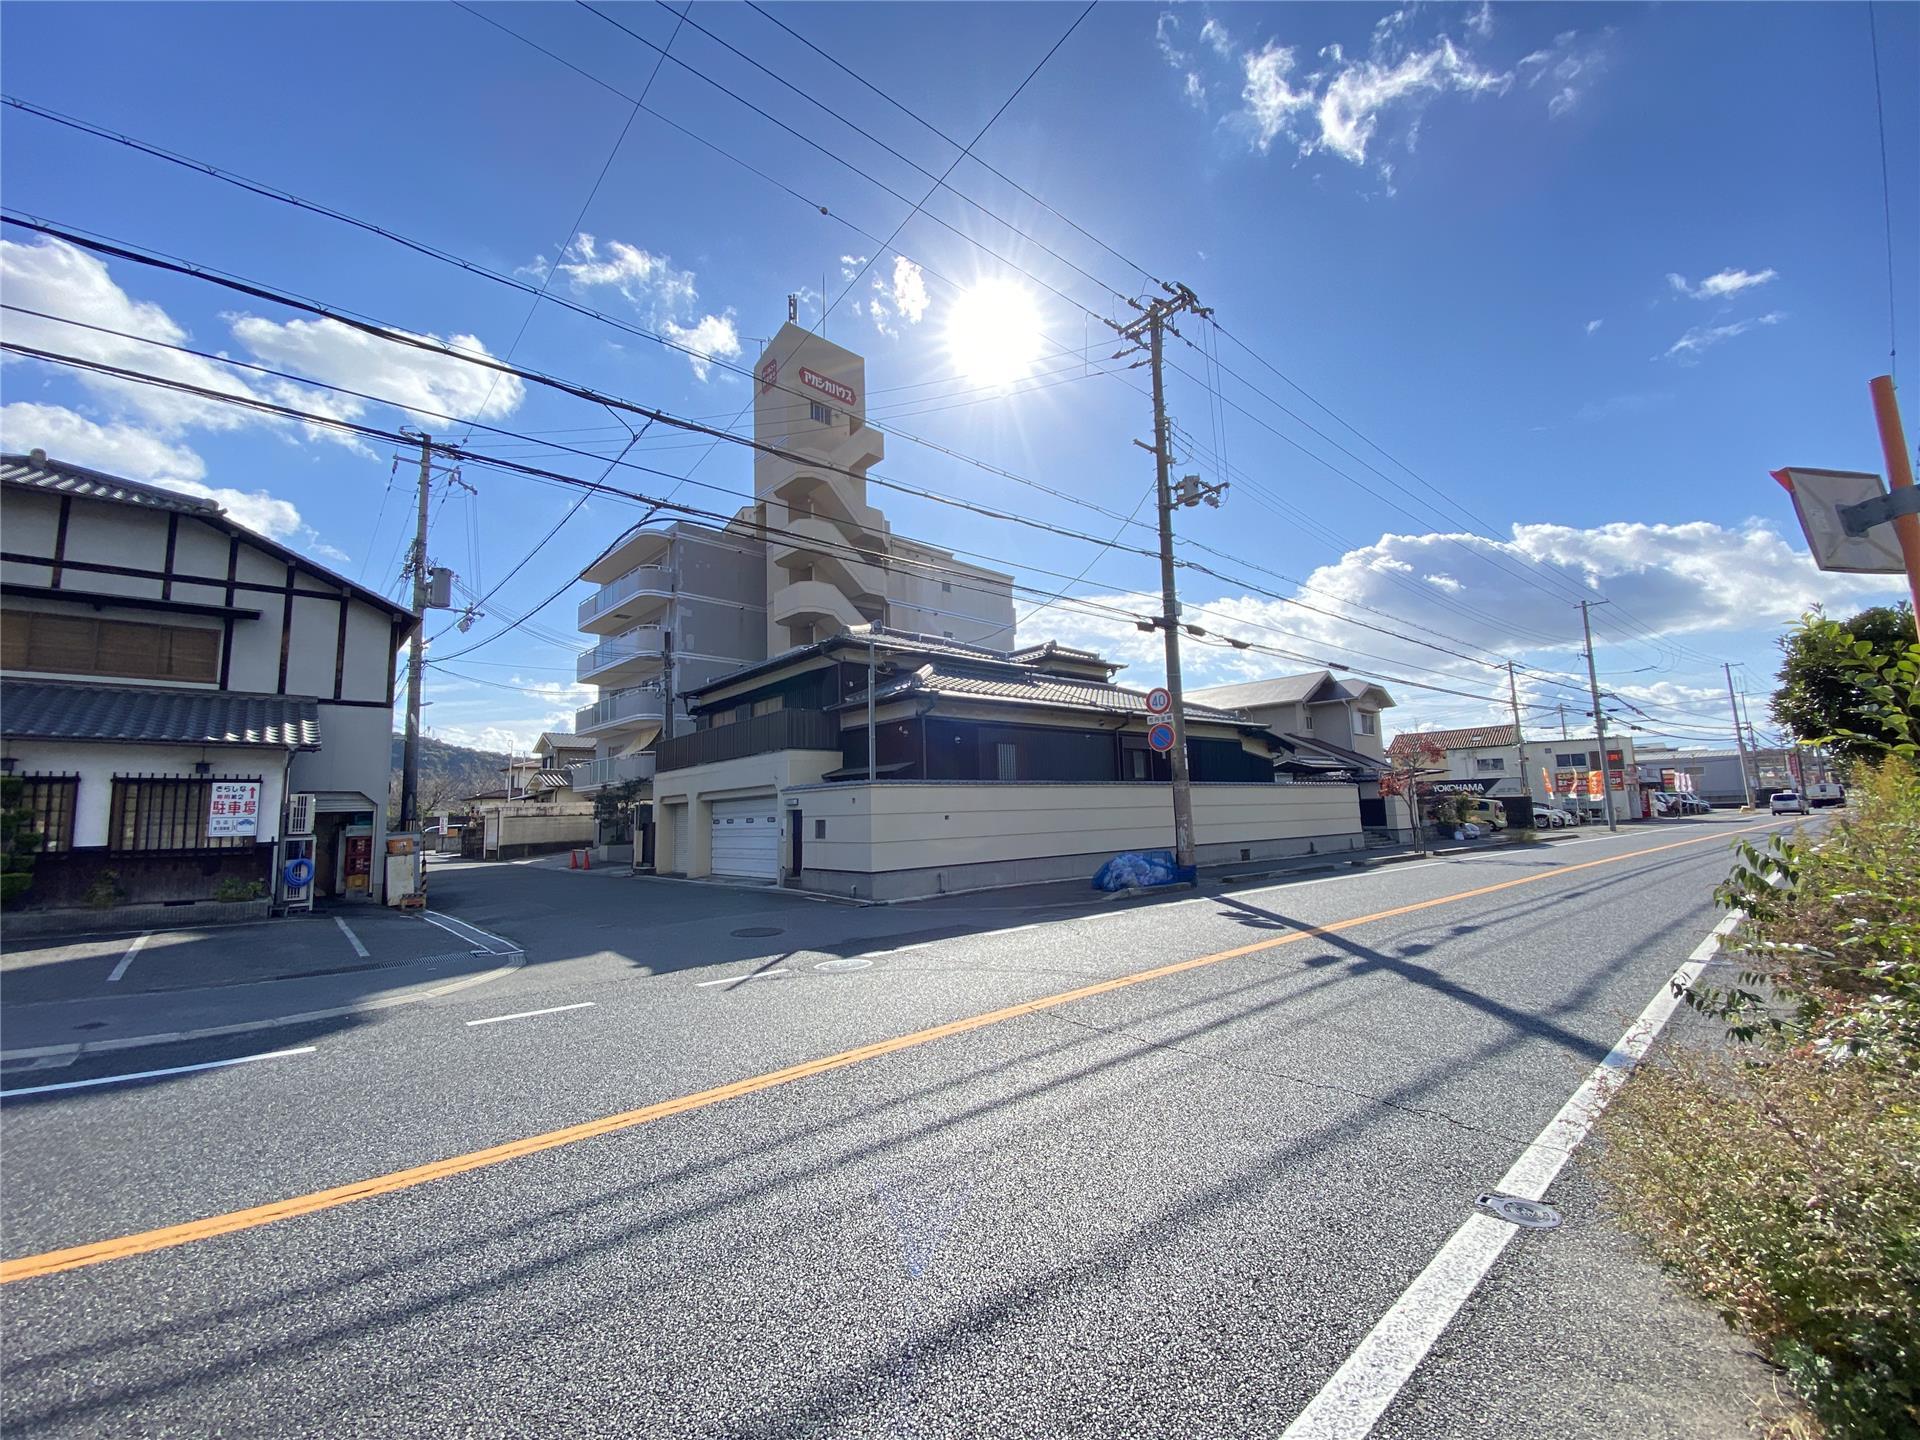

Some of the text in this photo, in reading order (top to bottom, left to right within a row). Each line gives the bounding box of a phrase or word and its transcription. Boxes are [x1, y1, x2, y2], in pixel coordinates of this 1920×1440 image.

[1152, 694, 1166, 707] 40
[1432, 783, 1485, 793] YOKOHAMA
[212, 800, 256, 816] 駐車場
